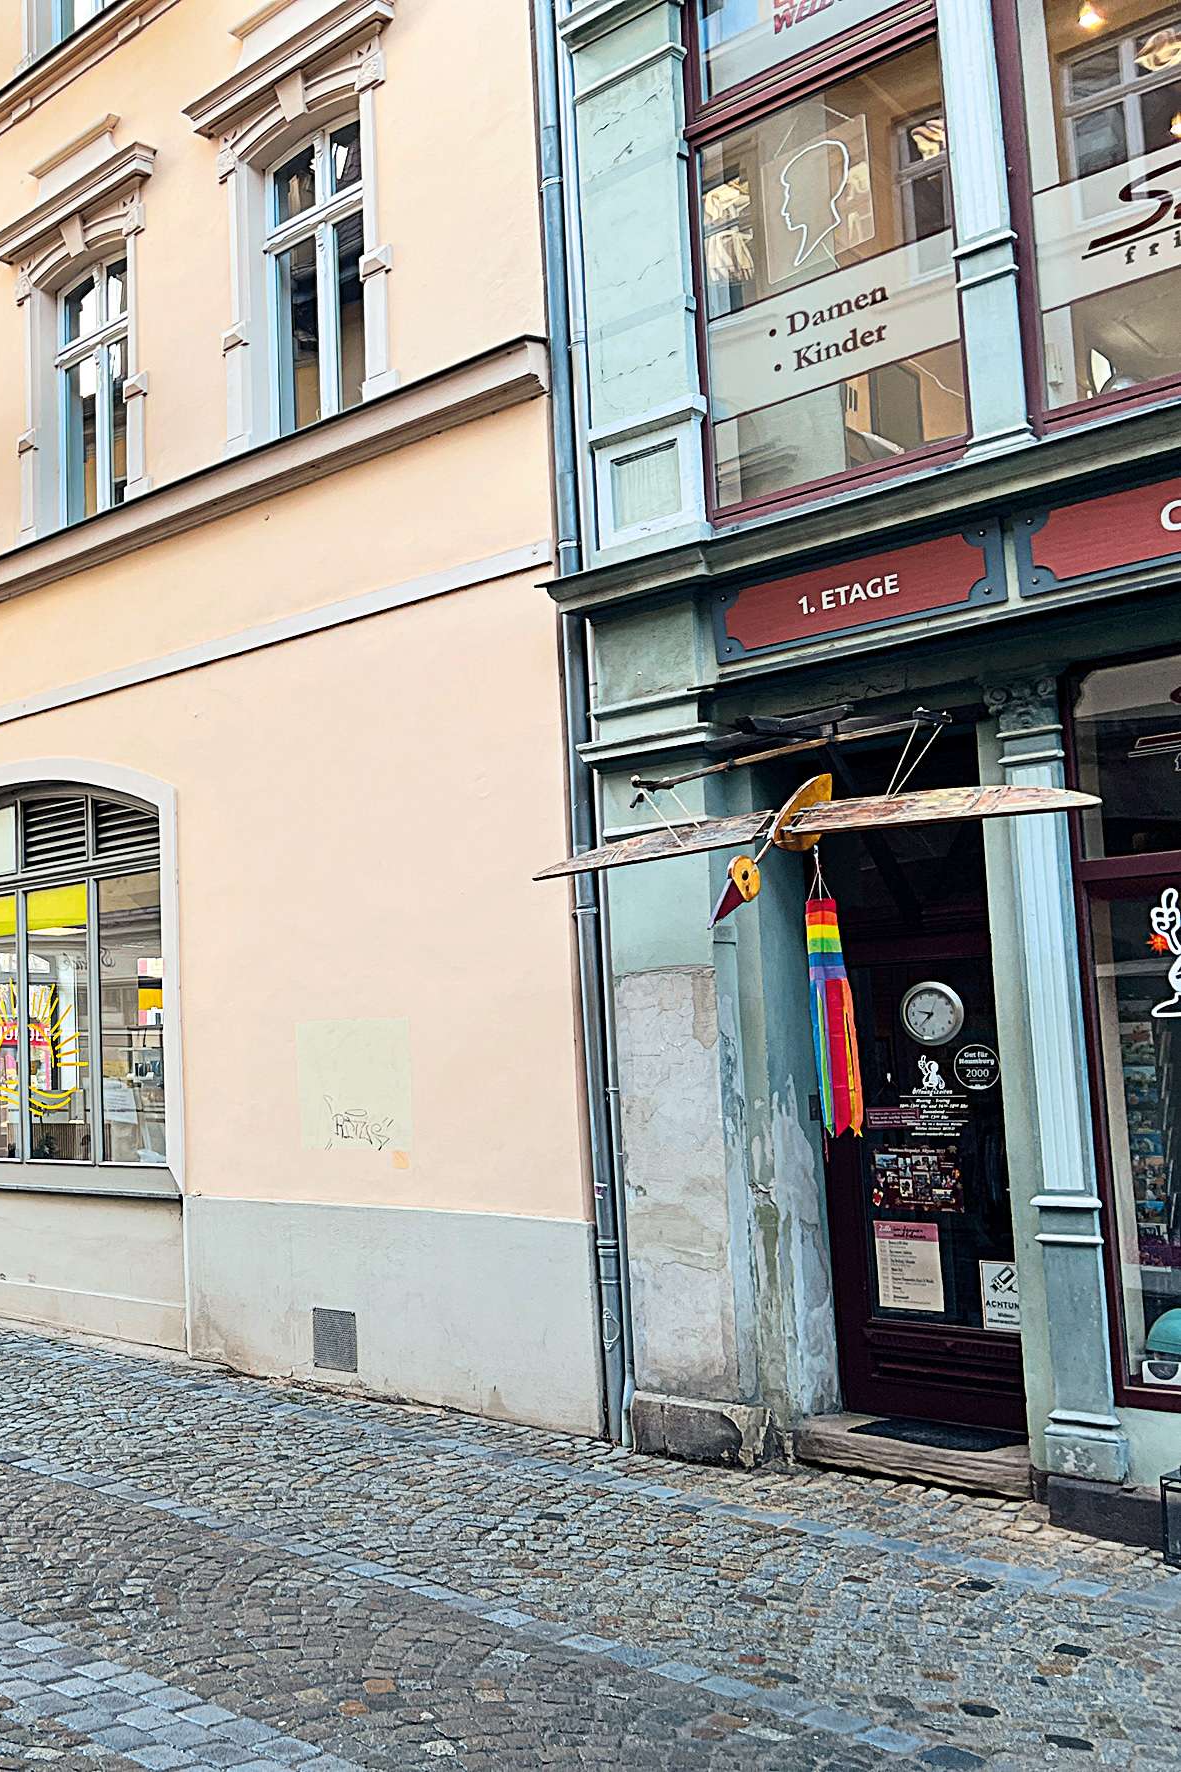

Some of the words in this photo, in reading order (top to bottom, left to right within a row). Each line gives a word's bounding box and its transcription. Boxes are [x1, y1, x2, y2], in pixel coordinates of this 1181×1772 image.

[786, 286, 889, 337] Damen
[793, 325, 887, 372] Kinder
[798, 595, 816, 615] 1.
[821, 573, 899, 610] ETAGE
[966, 1068, 990, 1078] 2000
